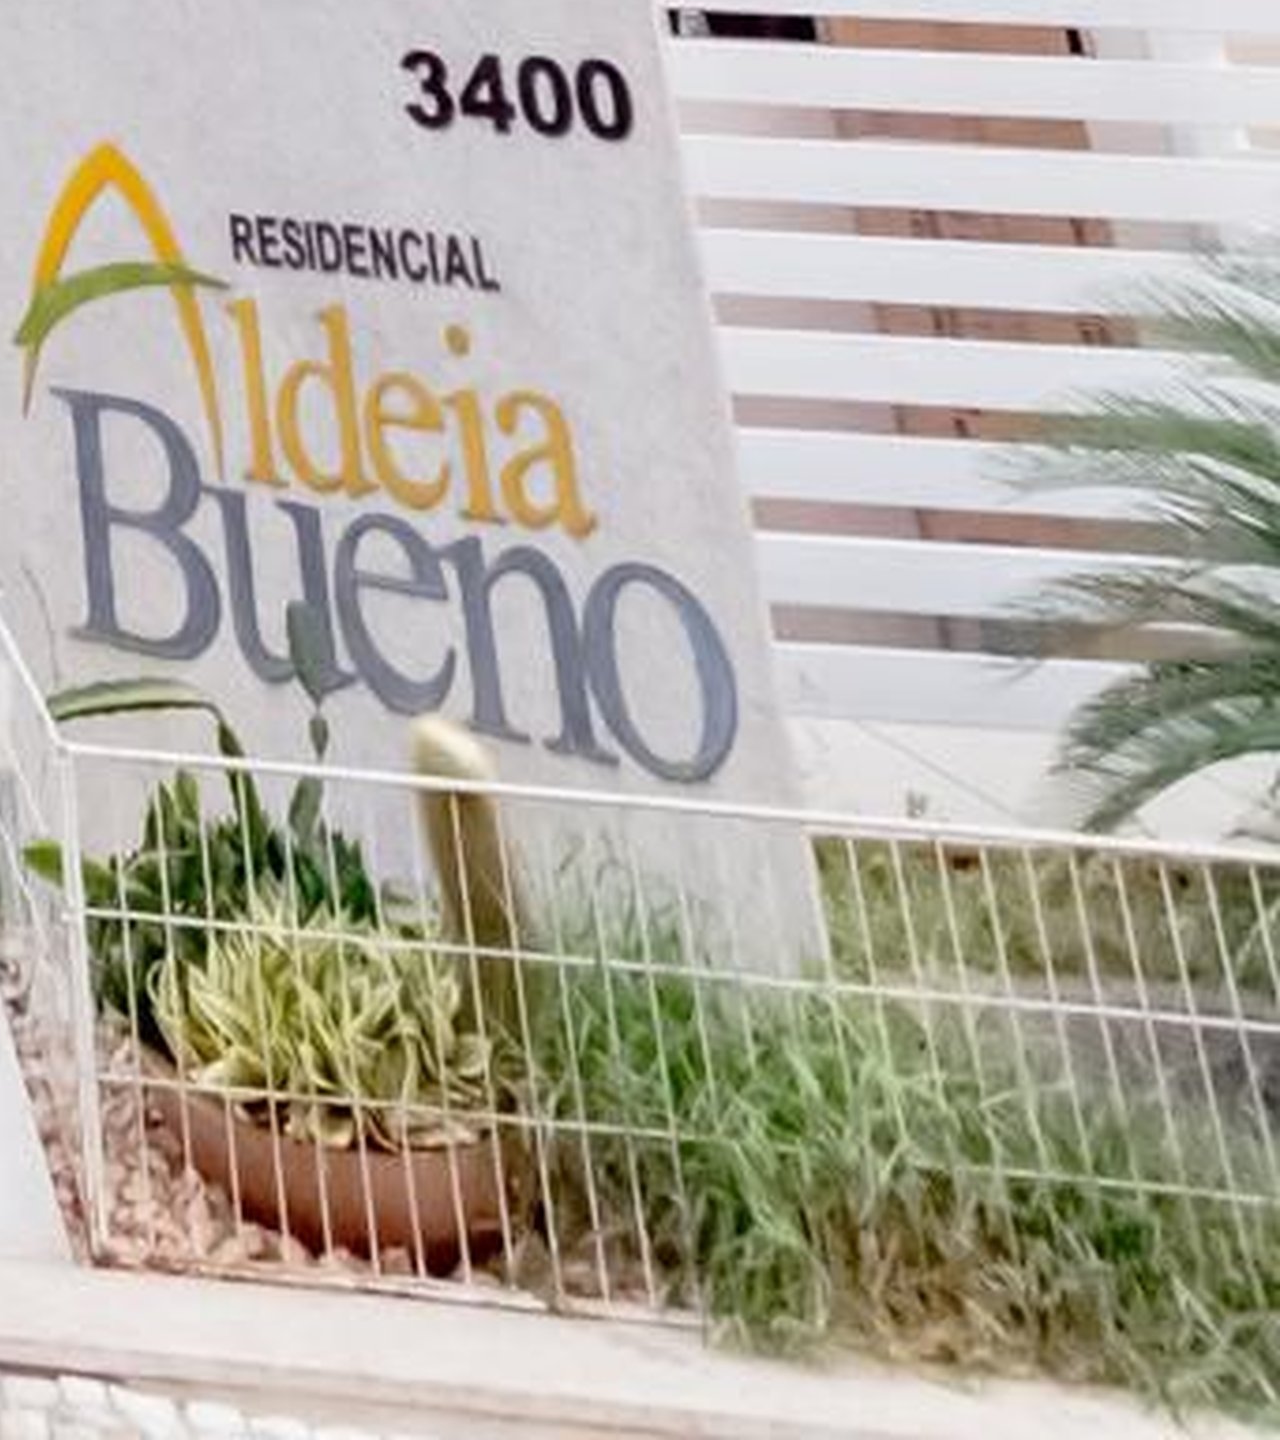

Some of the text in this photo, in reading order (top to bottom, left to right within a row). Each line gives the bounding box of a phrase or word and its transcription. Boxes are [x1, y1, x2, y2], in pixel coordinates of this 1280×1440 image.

[399, 49, 634, 142] 3400
[14, 140, 598, 541] Aldeia
[229, 213, 501, 292] RESIDENCIAL
[48, 384, 740, 785] Bueno
